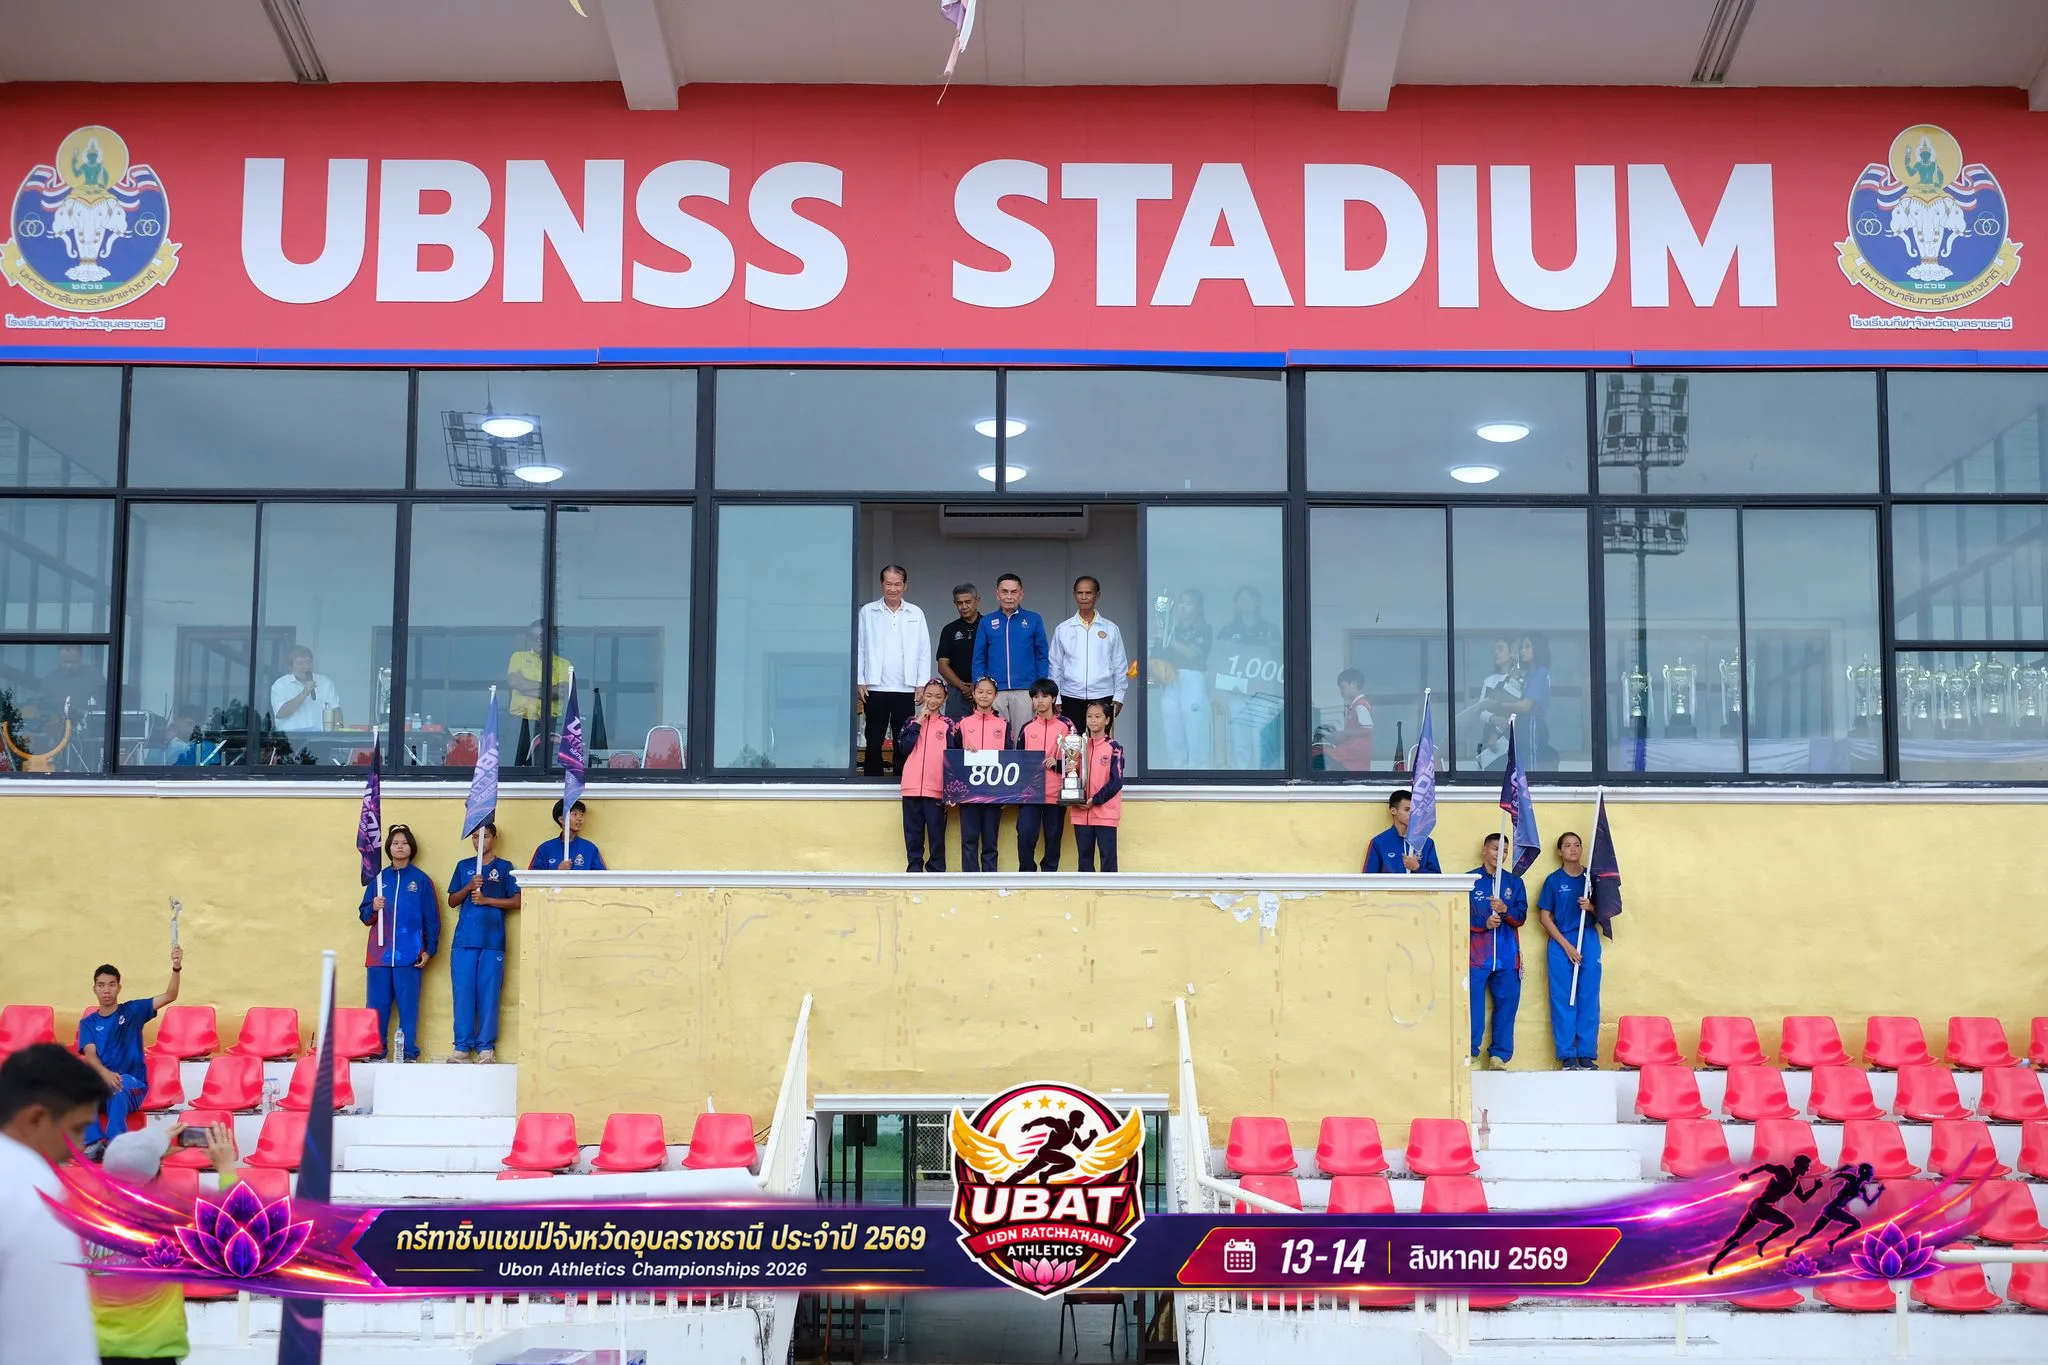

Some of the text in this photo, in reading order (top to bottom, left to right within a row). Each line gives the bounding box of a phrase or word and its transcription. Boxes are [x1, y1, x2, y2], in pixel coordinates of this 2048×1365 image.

[242, 158, 1777, 311] UBNSS STADIUM
[968, 762, 1020, 786] 800
